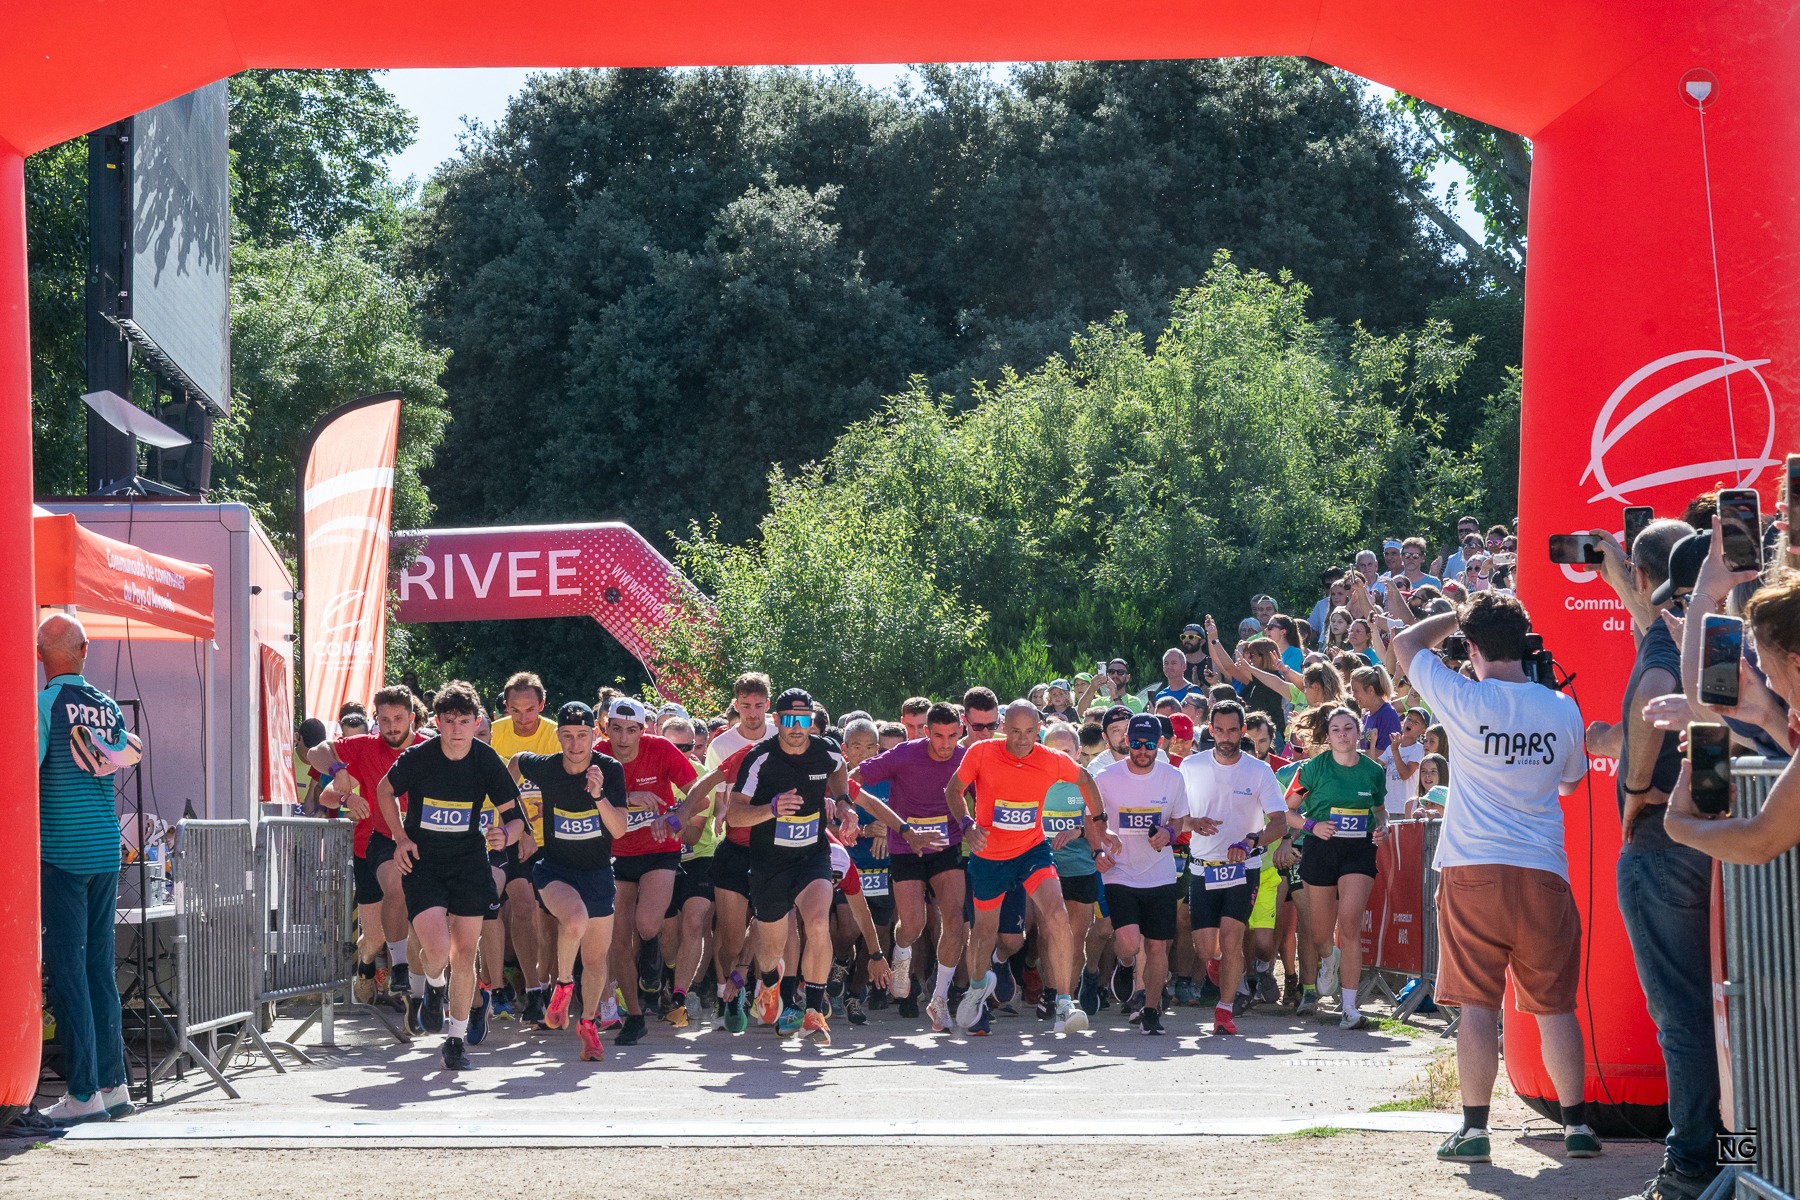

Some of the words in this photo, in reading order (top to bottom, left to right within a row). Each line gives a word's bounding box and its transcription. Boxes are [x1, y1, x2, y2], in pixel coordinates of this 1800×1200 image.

[400, 550, 581, 601] RIVEE
[1565, 596, 1625, 610] Commu
[1602, 617, 1625, 631] du
[313, 641, 374, 657] COMPA
[430, 809, 462, 824] 410
[1000, 809, 1031, 823] 386
[1127, 815, 1153, 827] 185
[560, 819, 593, 833] 485
[1049, 819, 1075, 831] 108
[1340, 817, 1359, 830] 52
[788, 824, 811, 839] 121
[1212, 866, 1237, 881] 187
